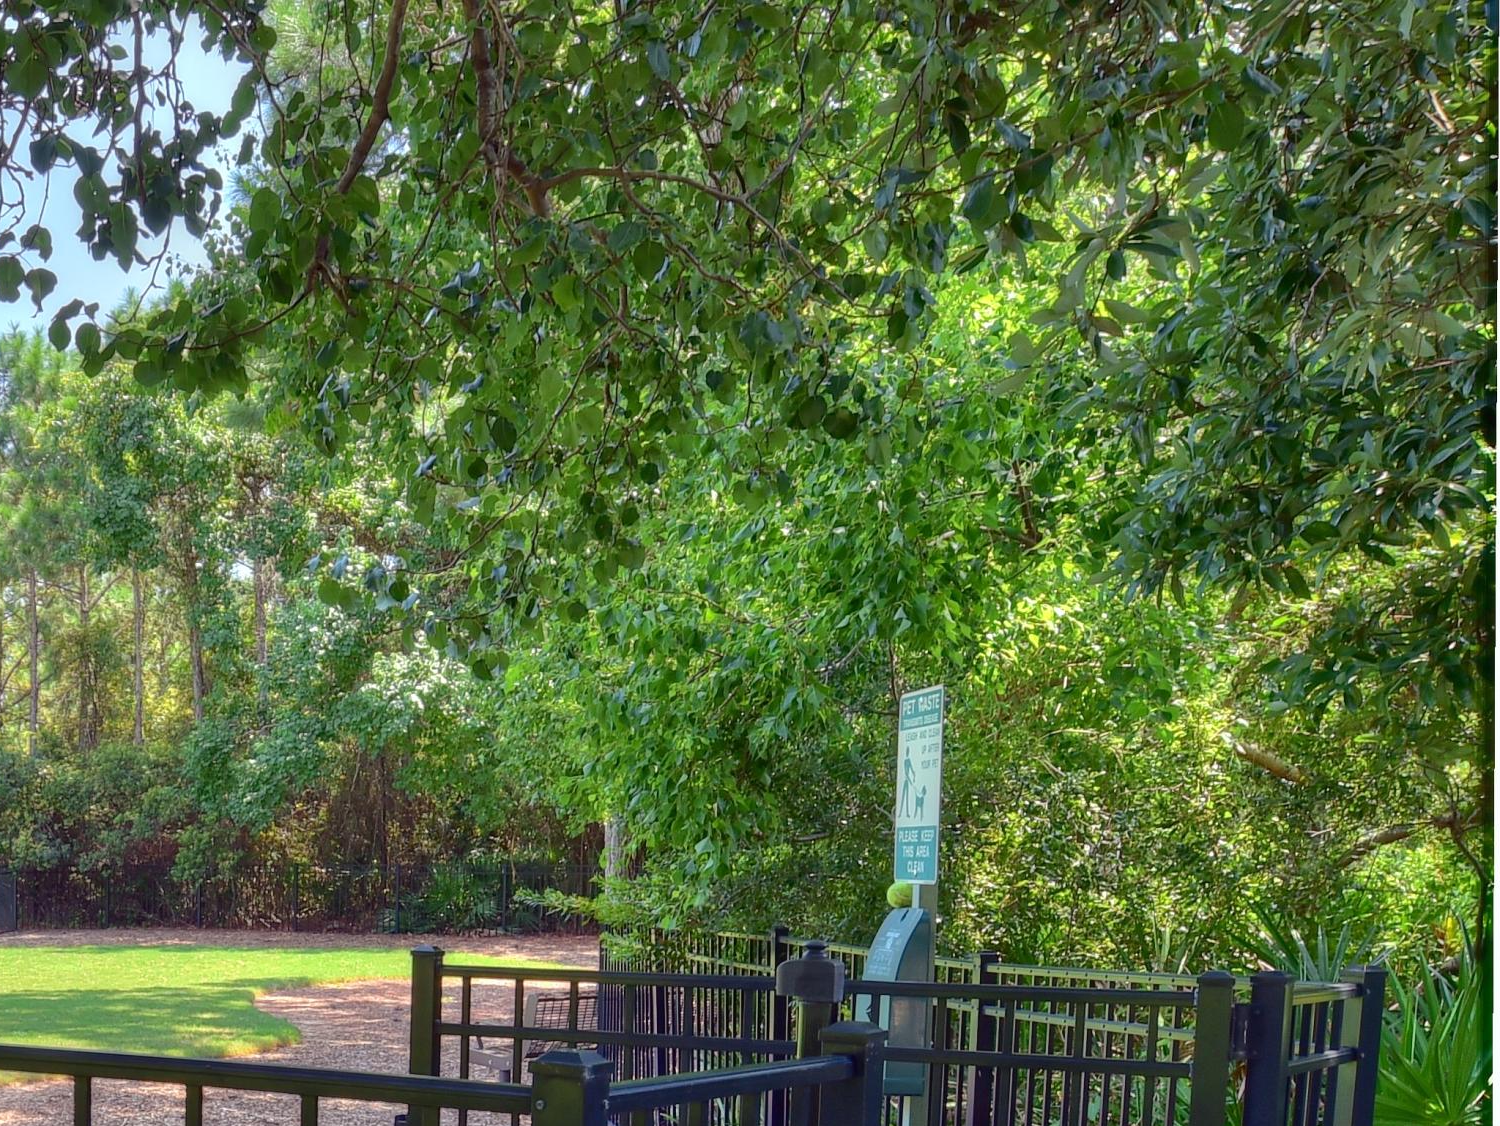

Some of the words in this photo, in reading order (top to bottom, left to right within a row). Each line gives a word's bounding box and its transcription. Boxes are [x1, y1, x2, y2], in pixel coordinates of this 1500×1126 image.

[903, 699, 916, 716] PET
[918, 692, 940, 712] WASTE
[898, 830, 918, 842] PLEASE
[920, 829, 934, 842] KEEP
[903, 845, 914, 857] THIS
[915, 845, 930, 857] AREA
[907, 861, 924, 873] CLEAN
